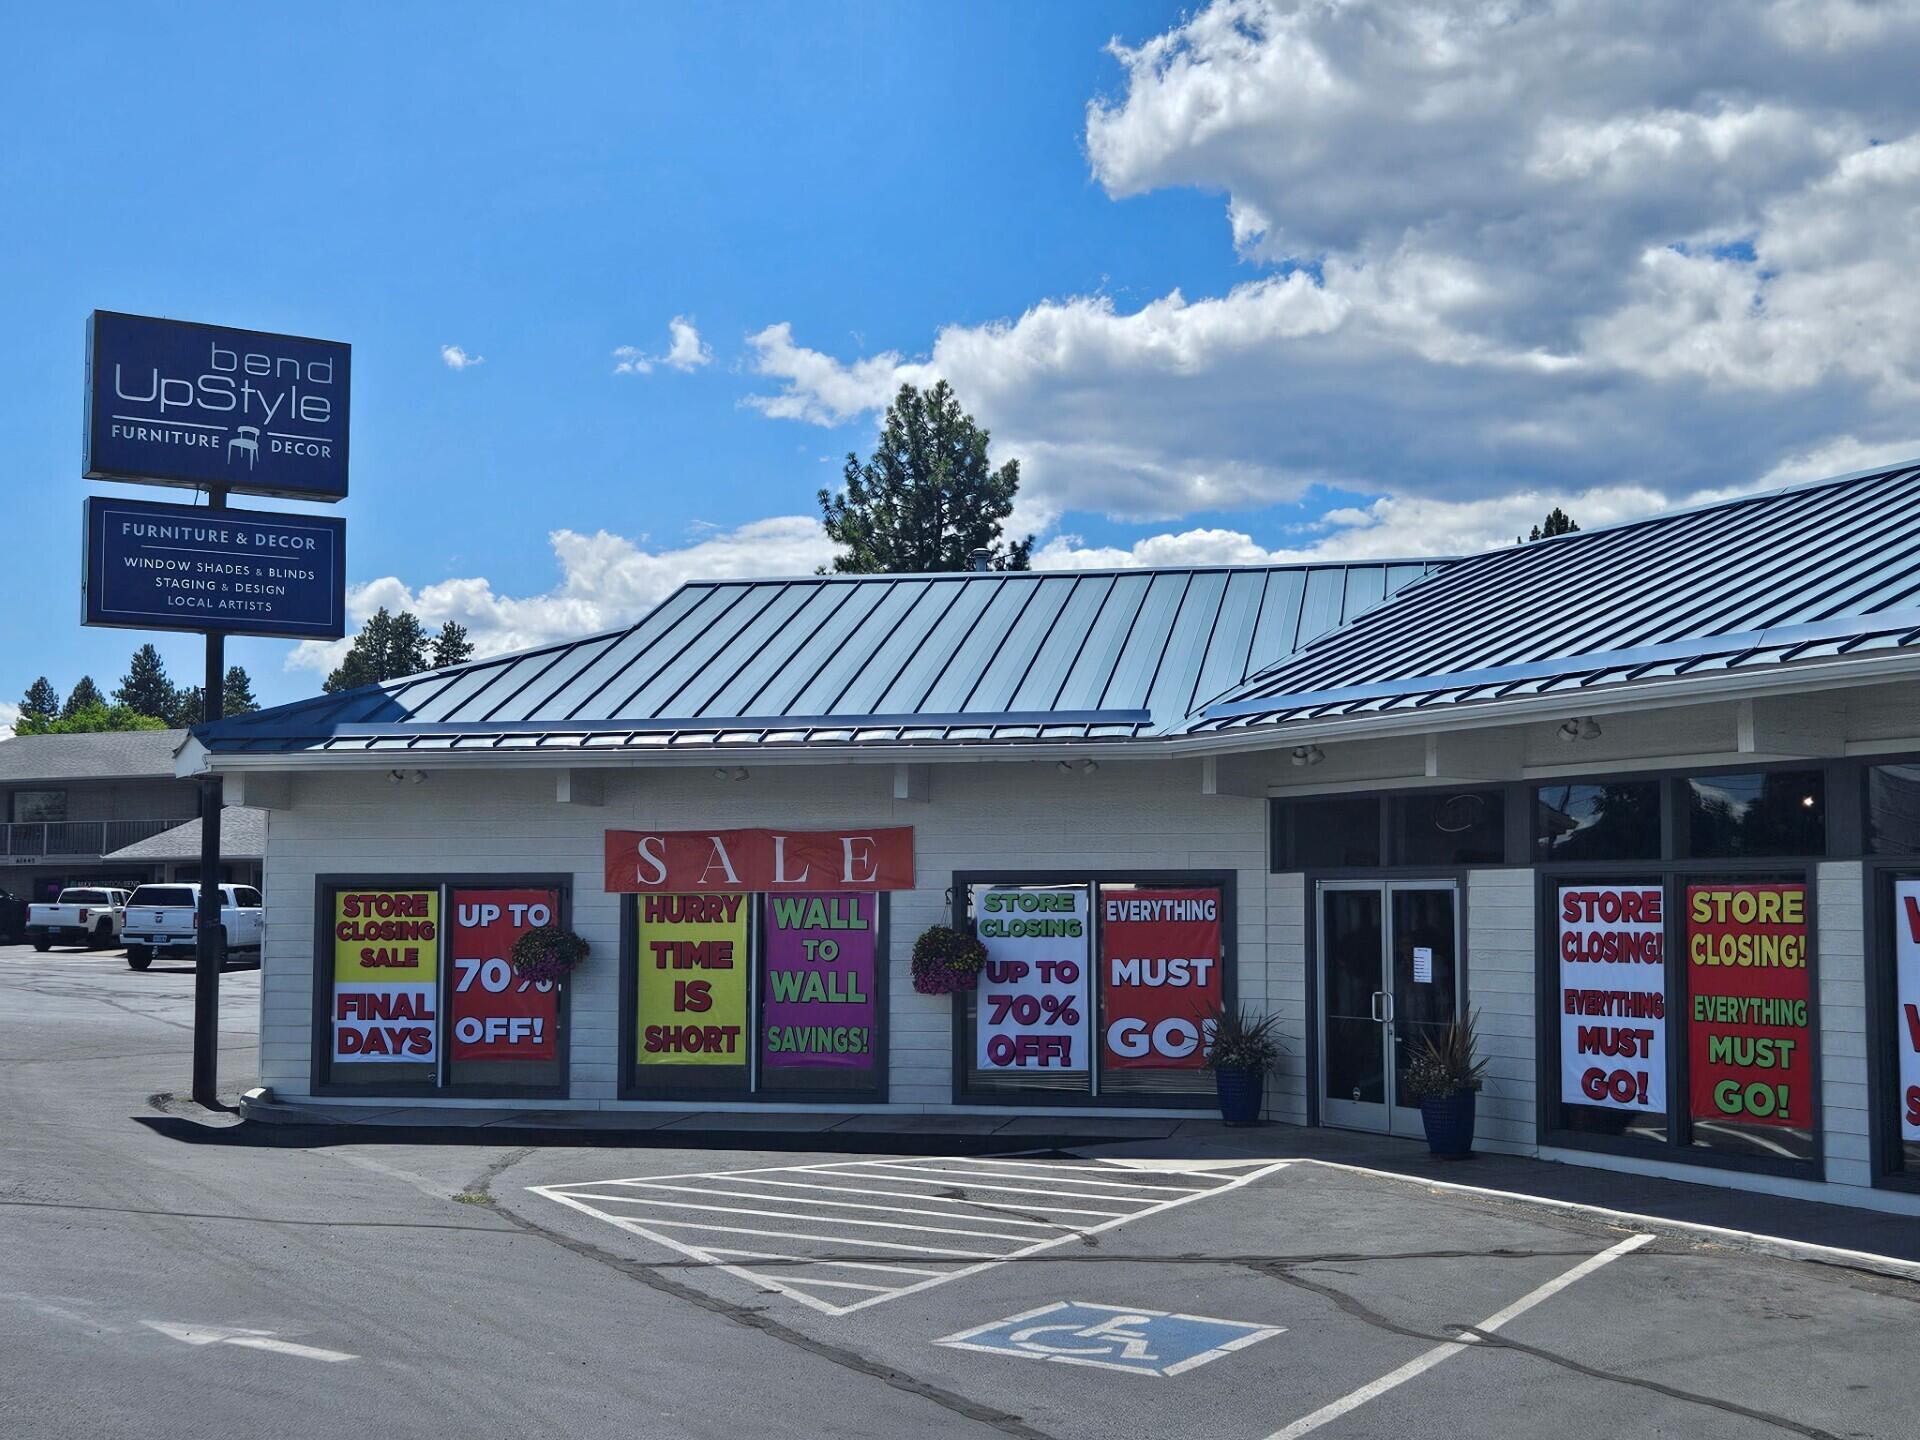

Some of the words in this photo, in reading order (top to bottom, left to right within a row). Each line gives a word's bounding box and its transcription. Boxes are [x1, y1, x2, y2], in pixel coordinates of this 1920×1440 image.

[211, 342, 333, 384] bend
[115, 363, 331, 425] UpStyle
[112, 425, 219, 448] FURNITURE
[271, 440, 332, 458] DECOR
[122, 522, 229, 544] FURNITURE
[236, 532, 248, 545] &
[255, 533, 316, 550] DECOR
[124, 557, 190, 572] WINDOW
[196, 562, 250, 576] SHADES
[255, 568, 262, 577] &
[268, 567, 315, 580] BLINDS
[155, 577, 216, 591] STAGING
[221, 582, 229, 591] &
[235, 583, 285, 596] DESIGN
[167, 596, 213, 609] LOCAL
[218, 599, 272, 612] ARTISTS
[637, 836, 878, 885] SALE
[343, 893, 429, 918] STORE
[458, 903, 500, 927] UP
[508, 903, 551, 927] TO
[644, 894, 743, 924] HURRY
[772, 898, 869, 930] WALL
[983, 893, 1075, 913] STORE
[1106, 899, 1216, 923] EVERYTHING
[1562, 890, 1662, 924] STORE
[1691, 890, 1805, 925] STORE
[336, 920, 435, 941] CLOSING
[979, 918, 1083, 938] CLOSING
[360, 947, 419, 968] SALE
[650, 940, 734, 970] TIME
[802, 939, 839, 962] TO
[1561, 930, 1664, 964] CLOSING!
[1690, 933, 1807, 969] CLOSING!
[770, 970, 867, 1003] WALL
[986, 960, 1030, 984] UP
[1035, 960, 1080, 984] TO
[1111, 958, 1214, 987] MUST
[337, 993, 435, 1021] FINAL
[673, 980, 713, 1013] IS
[987, 994, 1080, 1026] 70%
[1564, 989, 1665, 1020] EVERYTHING
[1694, 994, 1808, 1028] EVERYTHING
[337, 1027, 433, 1055] DAYS
[455, 1016, 544, 1044] OFF!
[644, 1025, 741, 1053] SHORT
[768, 1026, 869, 1054] SAVINGS!
[1577, 1026, 1654, 1059] MUST
[987, 1034, 1072, 1068] OFF!
[1709, 1035, 1796, 1069] MUST
[1581, 1067, 1649, 1105] GO!
[1713, 1079, 1790, 1119] GO!
